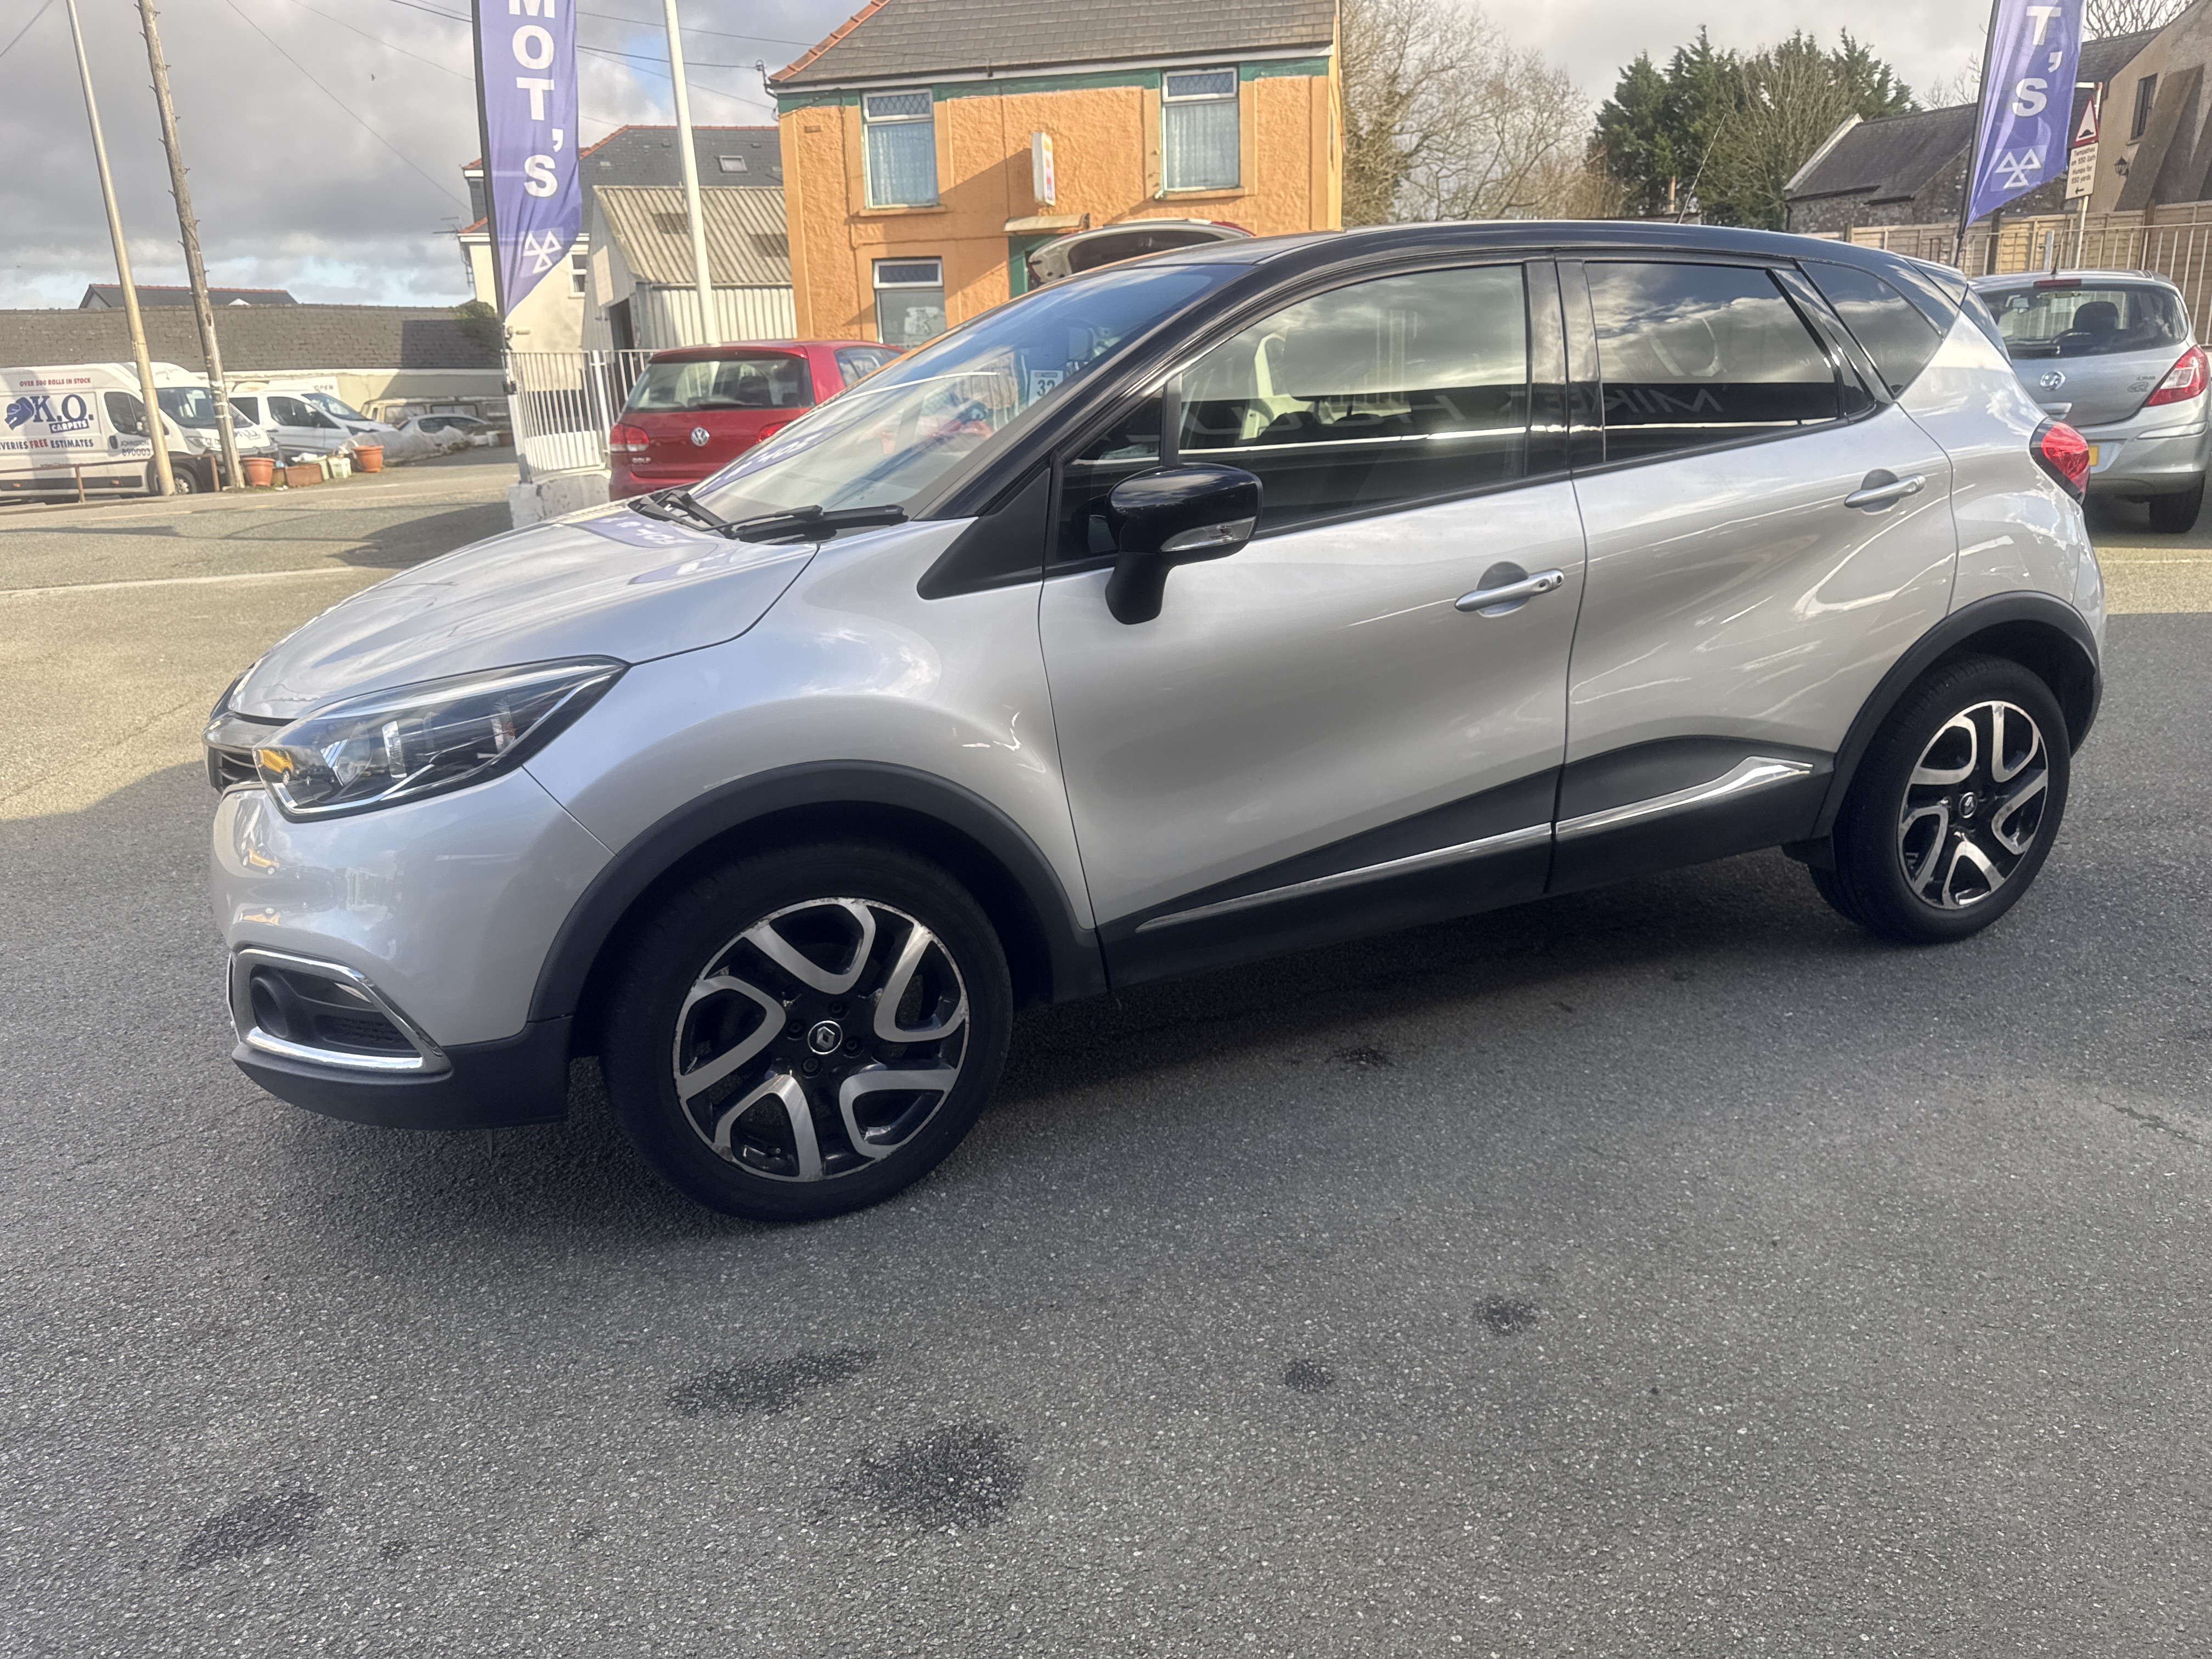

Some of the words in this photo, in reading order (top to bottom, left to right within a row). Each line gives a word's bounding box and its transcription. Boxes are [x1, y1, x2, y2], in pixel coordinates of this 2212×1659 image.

[52, 420, 87, 432] CARPETS
[0, 441, 28, 450] VERIES
[30, 439, 48, 449] FREE
[50, 439, 94, 448] ESTIMATES
[122, 448, 150, 456] 890003
